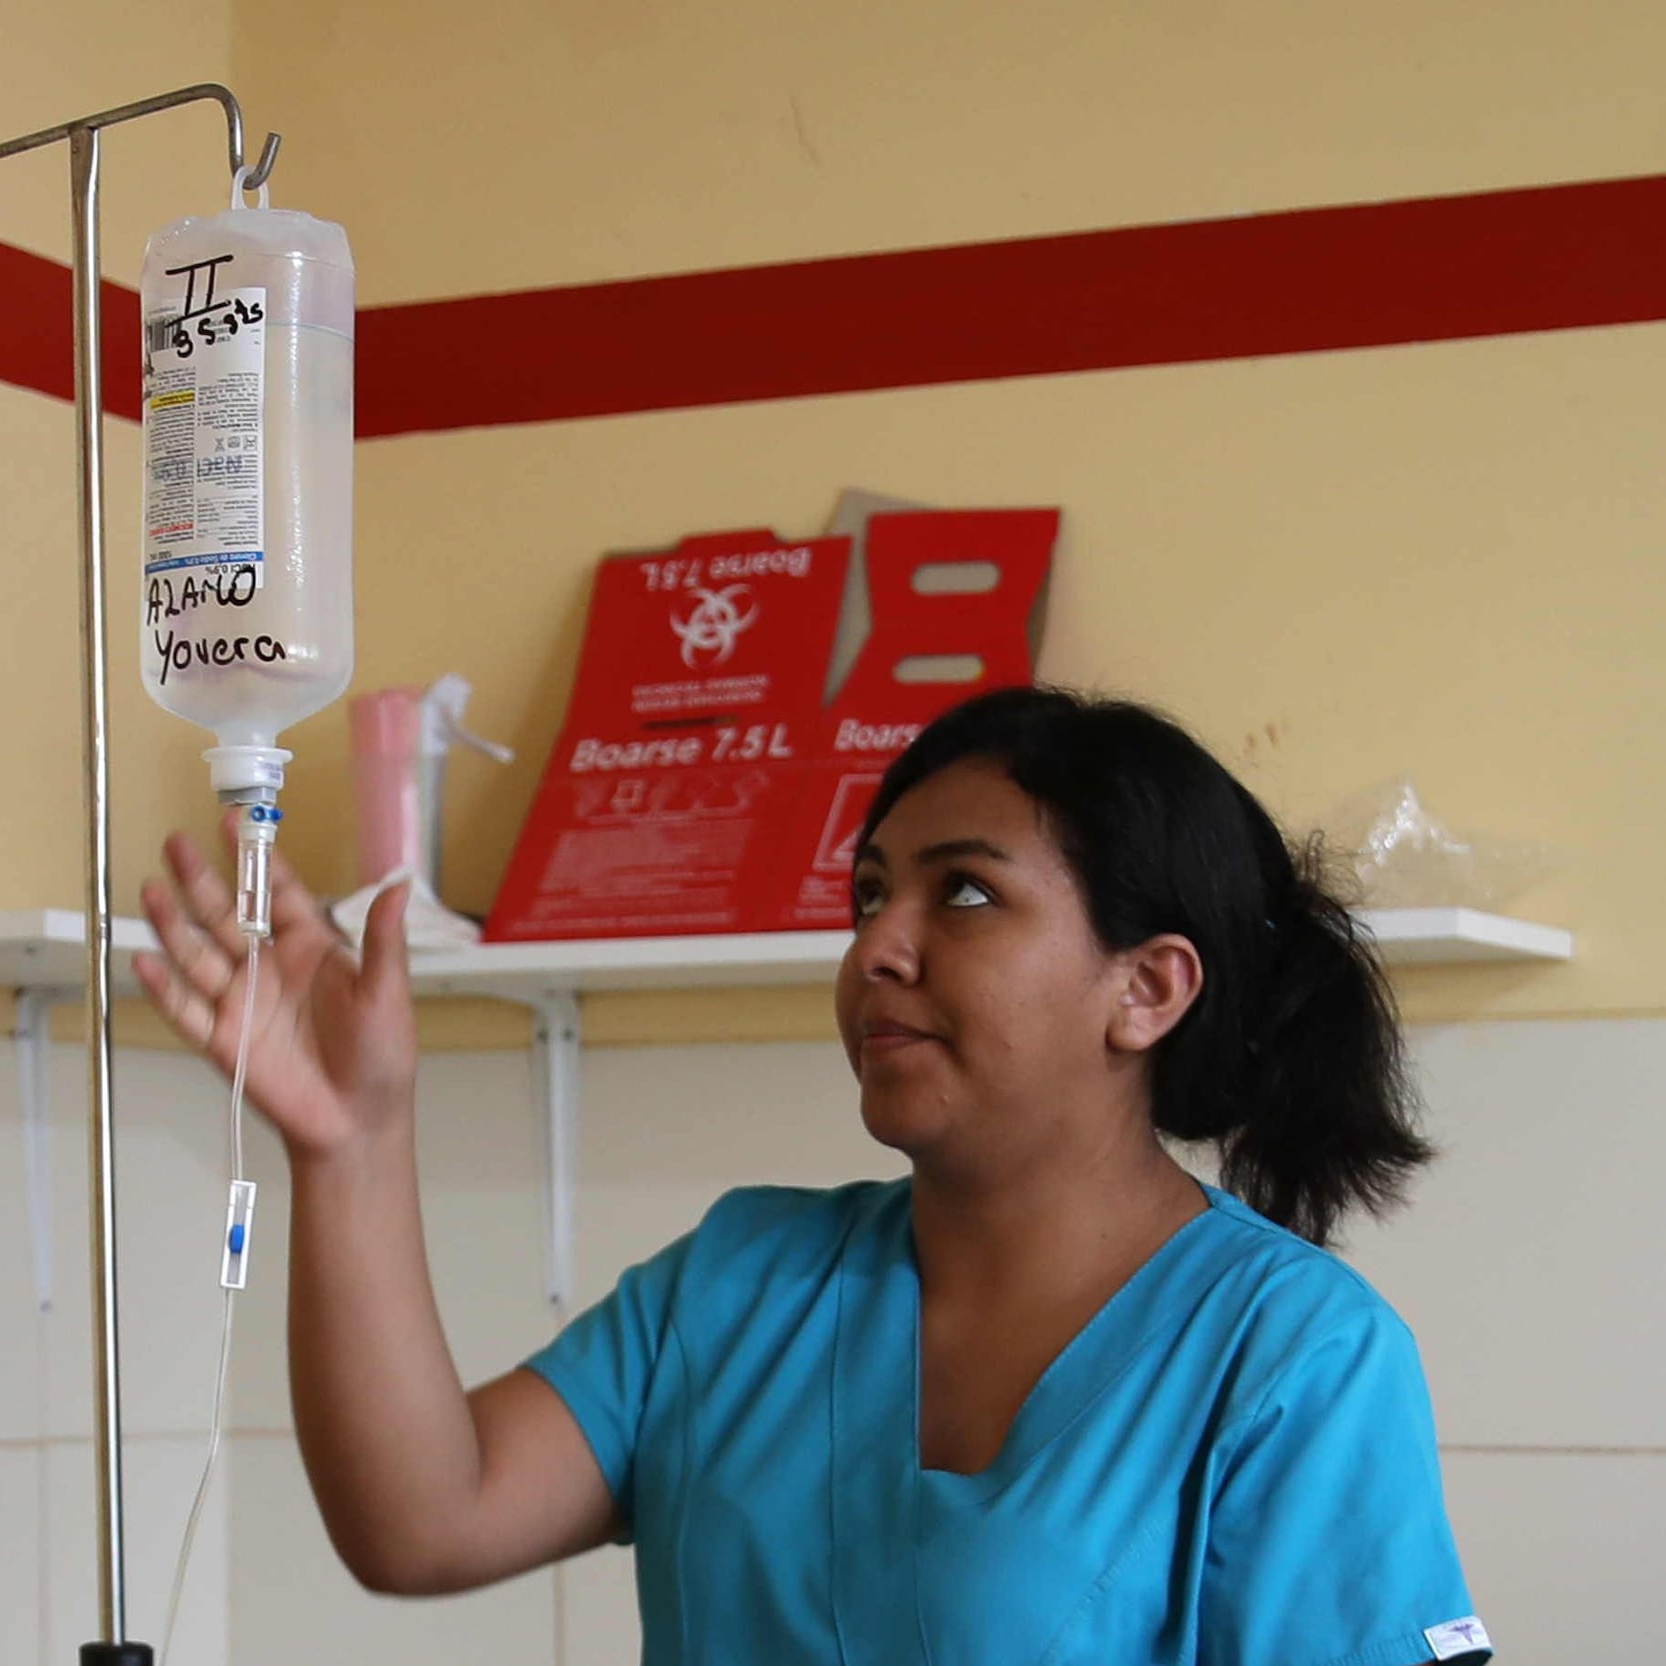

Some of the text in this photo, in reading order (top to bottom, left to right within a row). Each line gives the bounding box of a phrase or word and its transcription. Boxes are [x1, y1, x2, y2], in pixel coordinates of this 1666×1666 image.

[709, 547, 812, 578] Boarse
[154, 629, 287, 686] Yovera
[834, 718, 923, 751] Boars
[569, 737, 703, 773] Boarse
